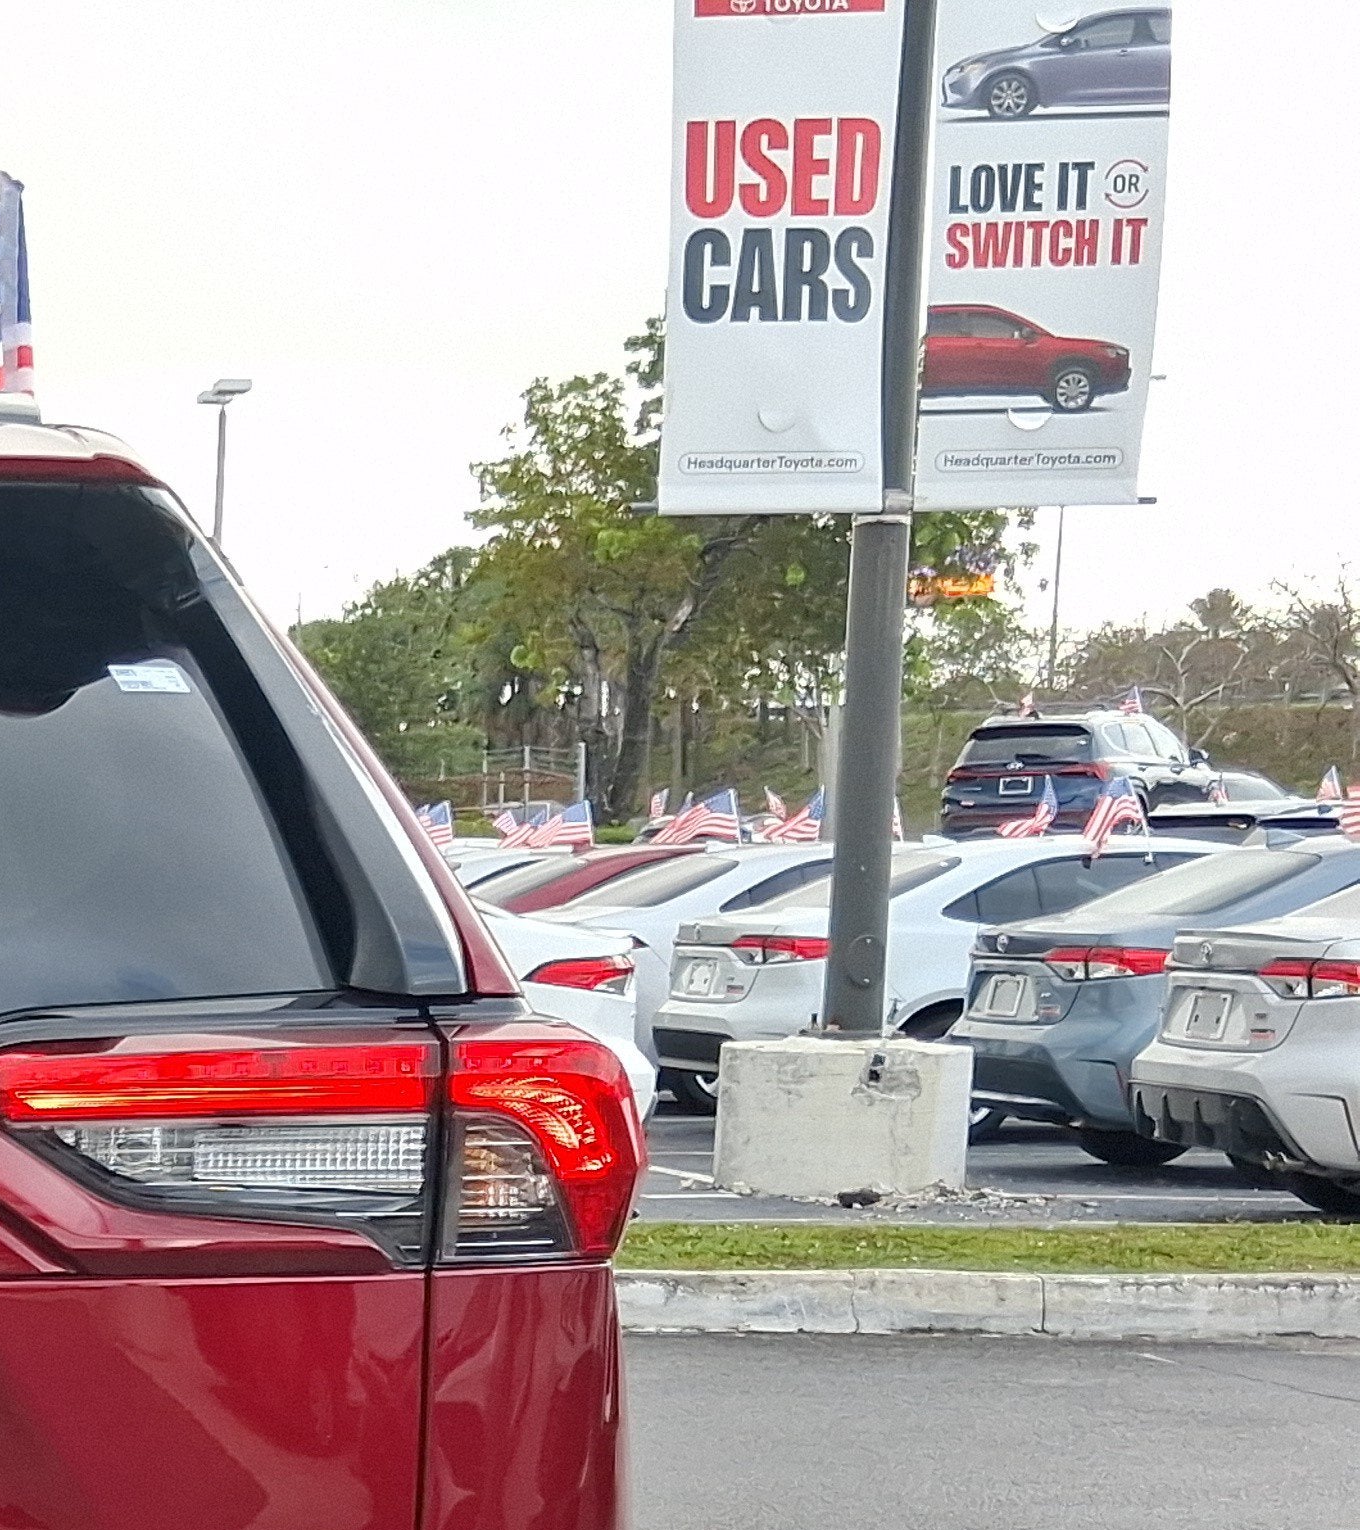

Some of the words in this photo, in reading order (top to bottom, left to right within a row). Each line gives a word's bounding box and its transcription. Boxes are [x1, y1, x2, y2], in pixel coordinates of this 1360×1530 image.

[685, 117, 882, 217] USED
[948, 162, 1045, 214] LOVE
[1056, 161, 1095, 211] IT
[1113, 174, 1140, 194] OR
[945, 219, 1100, 269] SWITCH
[1110, 217, 1148, 265] IT
[682, 227, 874, 324] CARS
[686, 455, 858, 472] HeadquarterToyota.com
[944, 453, 1117, 468] HeadquarterToyota.com
